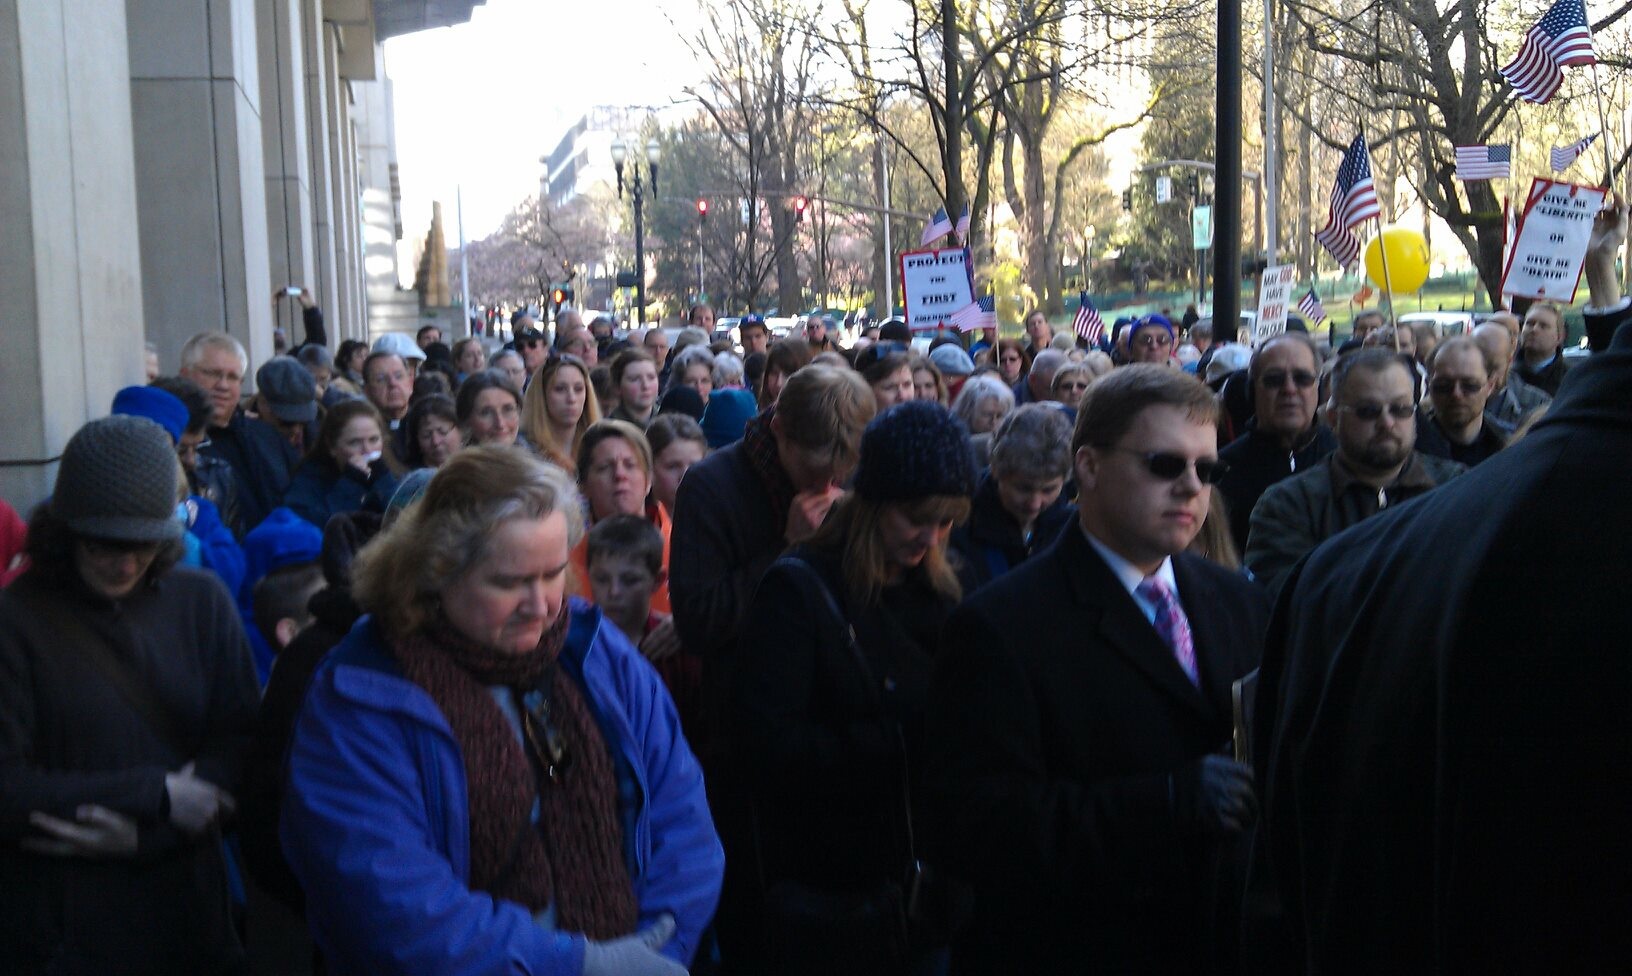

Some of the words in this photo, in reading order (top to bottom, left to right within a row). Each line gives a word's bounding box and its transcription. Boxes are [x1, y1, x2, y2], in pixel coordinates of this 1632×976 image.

[1543, 195, 1568, 205] GIVE
[1573, 199, 1587, 208] ME
[1550, 233, 1564, 244] OR
[907, 255, 964, 268] PROTECT
[1527, 254, 1552, 265] GIVE
[1556, 259, 1569, 269] ME
[1264, 274, 1278, 286] MAY
[922, 293, 956, 304] FIRST
[1266, 288, 1283, 300] HAVE
[1262, 304, 1283, 320] MERCY
